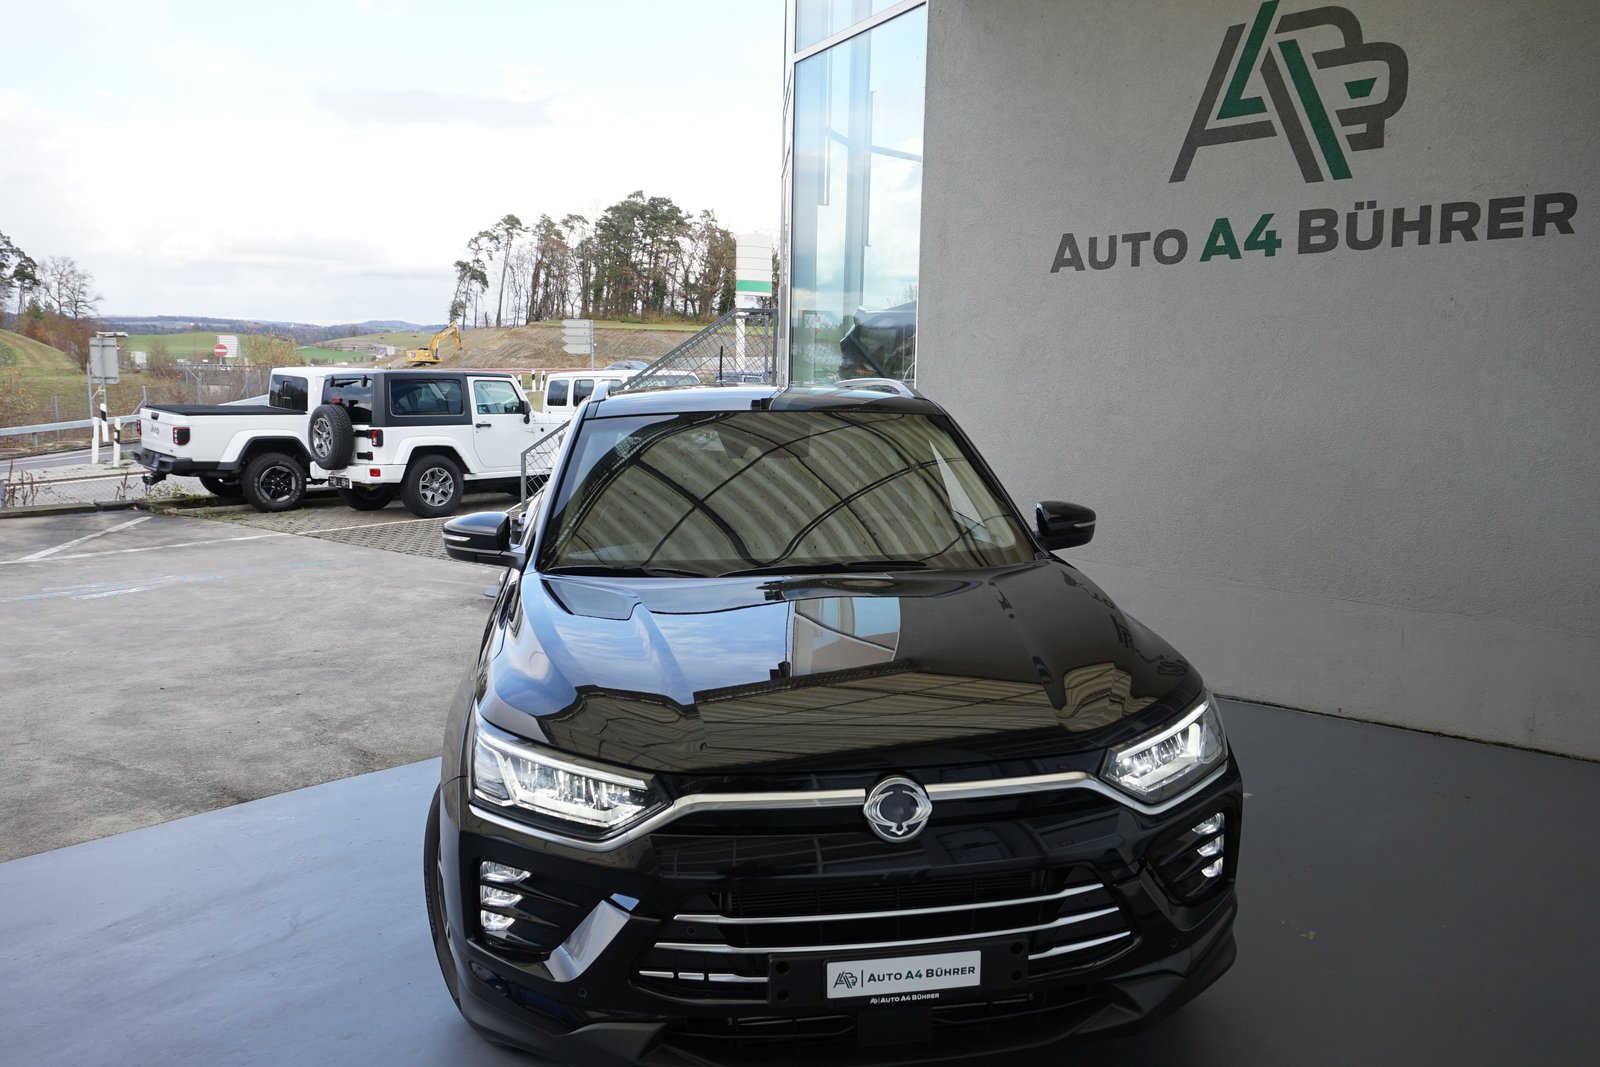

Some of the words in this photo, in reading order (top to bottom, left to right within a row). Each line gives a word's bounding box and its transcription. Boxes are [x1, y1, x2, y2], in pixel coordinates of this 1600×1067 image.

[1050, 229, 1188, 273] AUTO
[1199, 213, 1283, 262] A4
[1297, 192, 1578, 255] BÜHRER
[867, 973, 902, 983] AUTO
[905, 969, 923, 980] A4
[926, 966, 976, 978] BÜHRER
[912, 993, 940, 1001] BÜHRER
